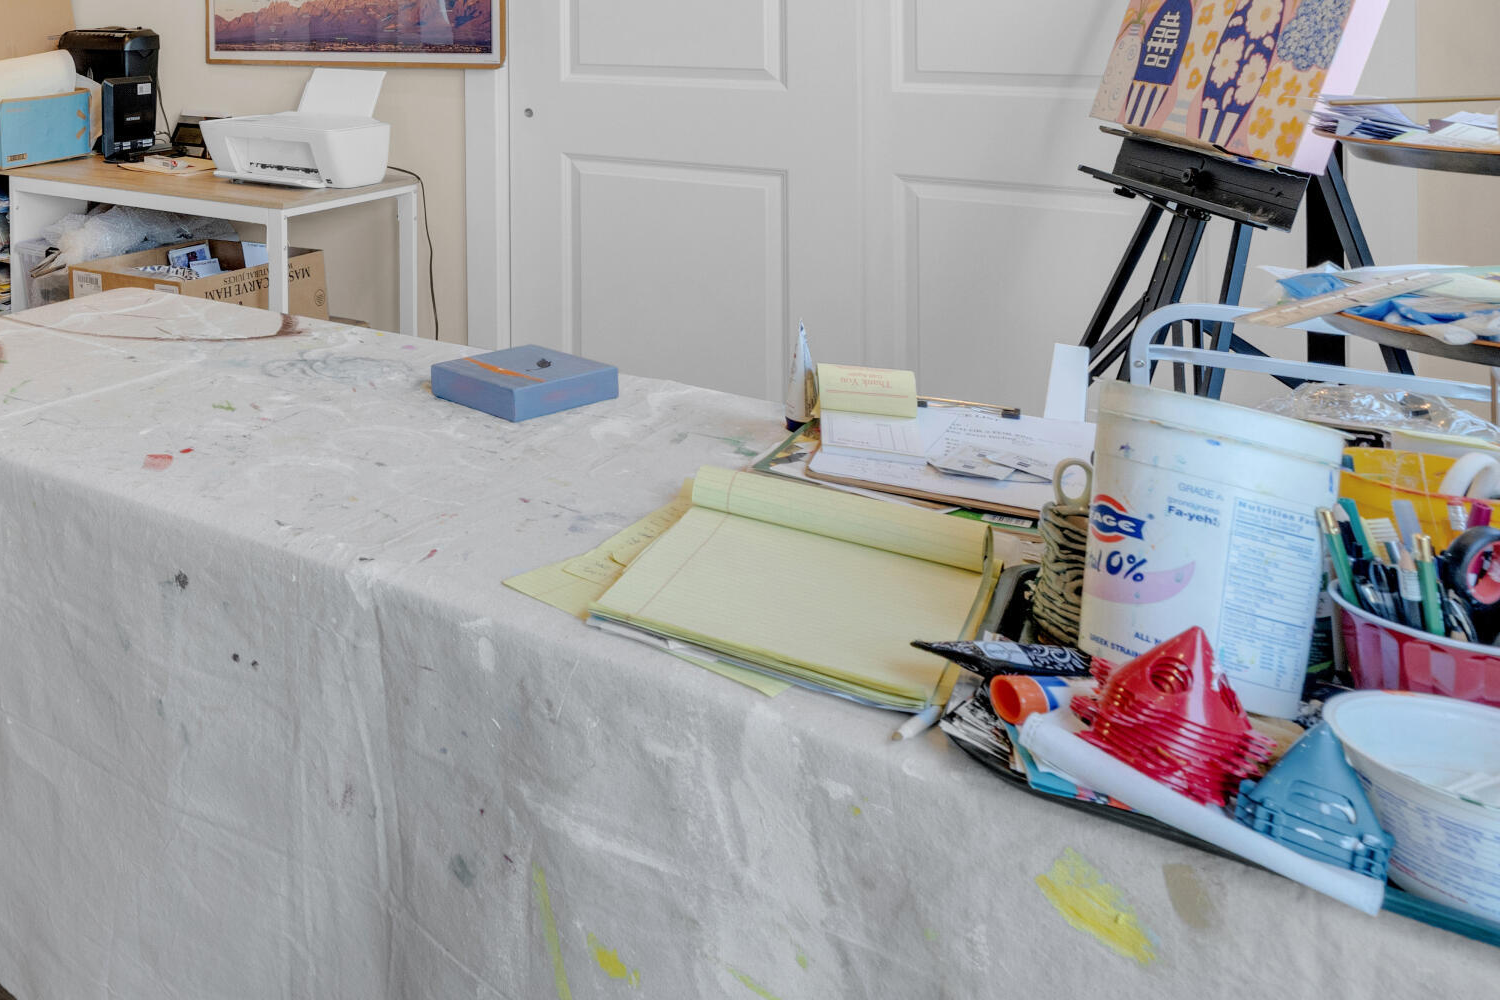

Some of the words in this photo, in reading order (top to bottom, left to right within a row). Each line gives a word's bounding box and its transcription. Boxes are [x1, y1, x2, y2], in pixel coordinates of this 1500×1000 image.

[223, 273, 245, 286] JUICES
[288, 267, 311, 284] MAS
[840, 377, 859, 386] You
[861, 378, 893, 389] Thank
[1178, 482, 1214, 500] GRADE
[1238, 500, 1295, 521] Nutrition
[1090, 511, 1137, 533] AGE
[1105, 550, 1148, 583] 0%
[1133, 631, 1151, 643] ALL
